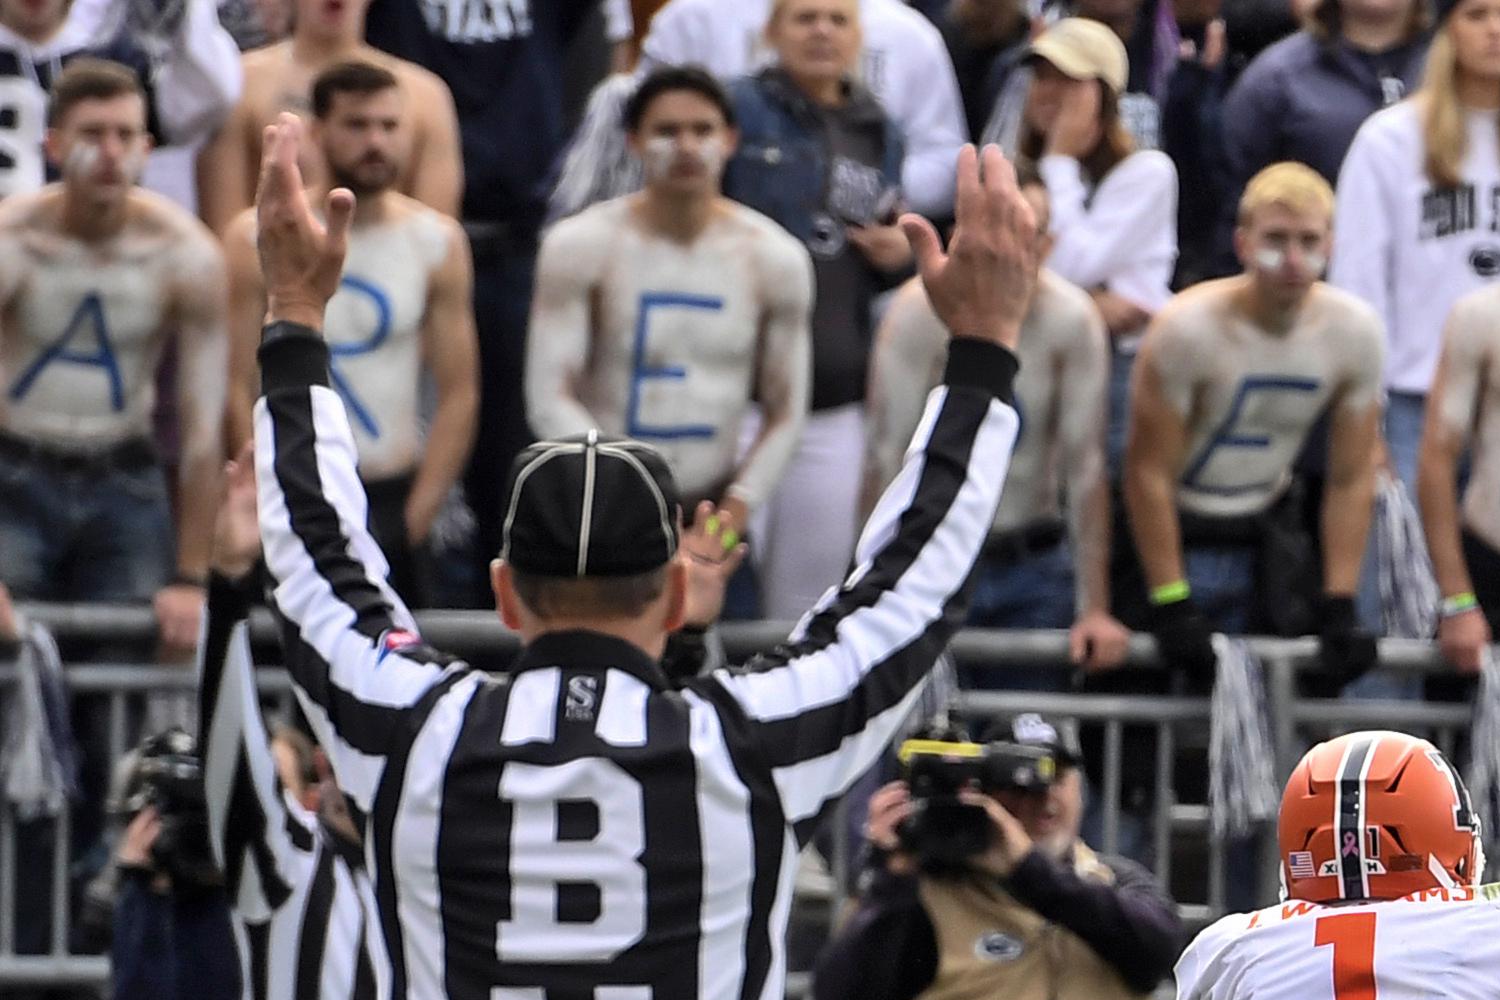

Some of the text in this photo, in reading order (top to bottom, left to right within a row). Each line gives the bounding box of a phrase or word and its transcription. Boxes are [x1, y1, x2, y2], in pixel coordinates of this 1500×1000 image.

[9, 292, 127, 413] A
[627, 292, 724, 440] E
[1177, 376, 1322, 496] E
[566, 674, 597, 709] S
[496, 758, 648, 963] B
[1366, 825, 1380, 859] 1
